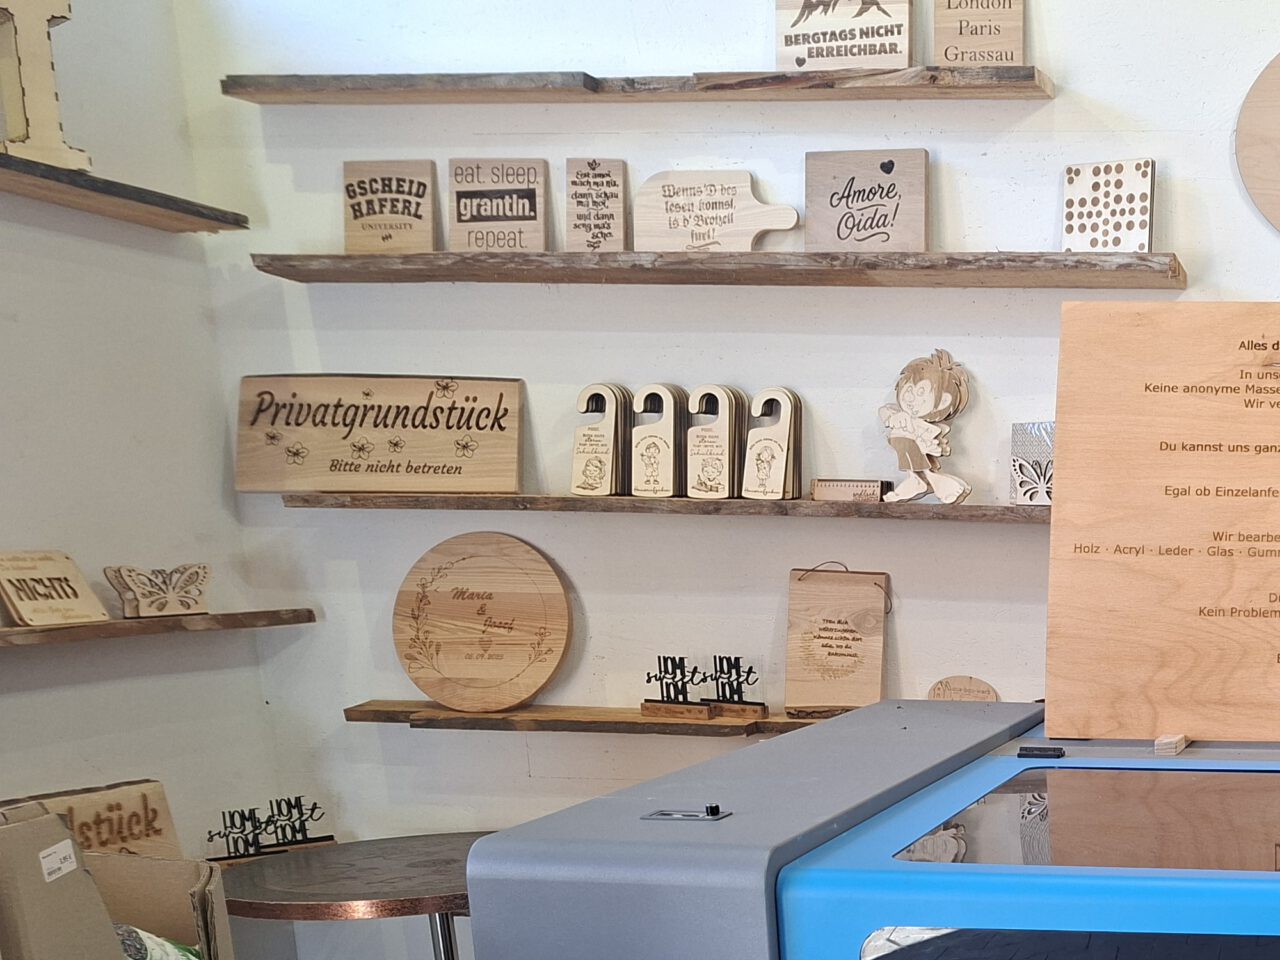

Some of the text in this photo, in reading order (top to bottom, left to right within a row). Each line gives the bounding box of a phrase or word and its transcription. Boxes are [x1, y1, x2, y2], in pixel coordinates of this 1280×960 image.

[946, 0, 1013, 10] London
[784, 24, 904, 47] BERGTAGS NICHT
[958, 20, 1001, 36] Paris
[807, 42, 902, 59] ERREICHBAR.
[944, 45, 1014, 62] Grassau
[454, 164, 539, 188] eat. sleep.
[345, 177, 427, 199] GSCHEID
[571, 191, 619, 200] dann schau
[830, 176, 902, 210] Amore,
[350, 198, 423, 221] HAFERL
[593, 212, 615, 221] dann
[361, 222, 413, 232] UNIVERSITY
[836, 202, 900, 241] Oida!
[467, 228, 528, 250] repeat.
[1238, 339, 1268, 351] Alles
[1144, 382, 1179, 393] Keine
[1182, 385, 1241, 396] anonyme
[250, 390, 510, 441] Privatgrundstück
[329, 459, 463, 475] Bitte nicht betreten
[1164, 485, 1191, 499] Egal
[1195, 485, 1211, 497] ob
[1212, 531, 1234, 542] Wir
[1073, 542, 1100, 554] Holz
[1113, 543, 1145, 557] Acryl
[1158, 544, 1194, 556] Leder
[1206, 545, 1234, 558] Glas
[450, 587, 494, 601] Maria
